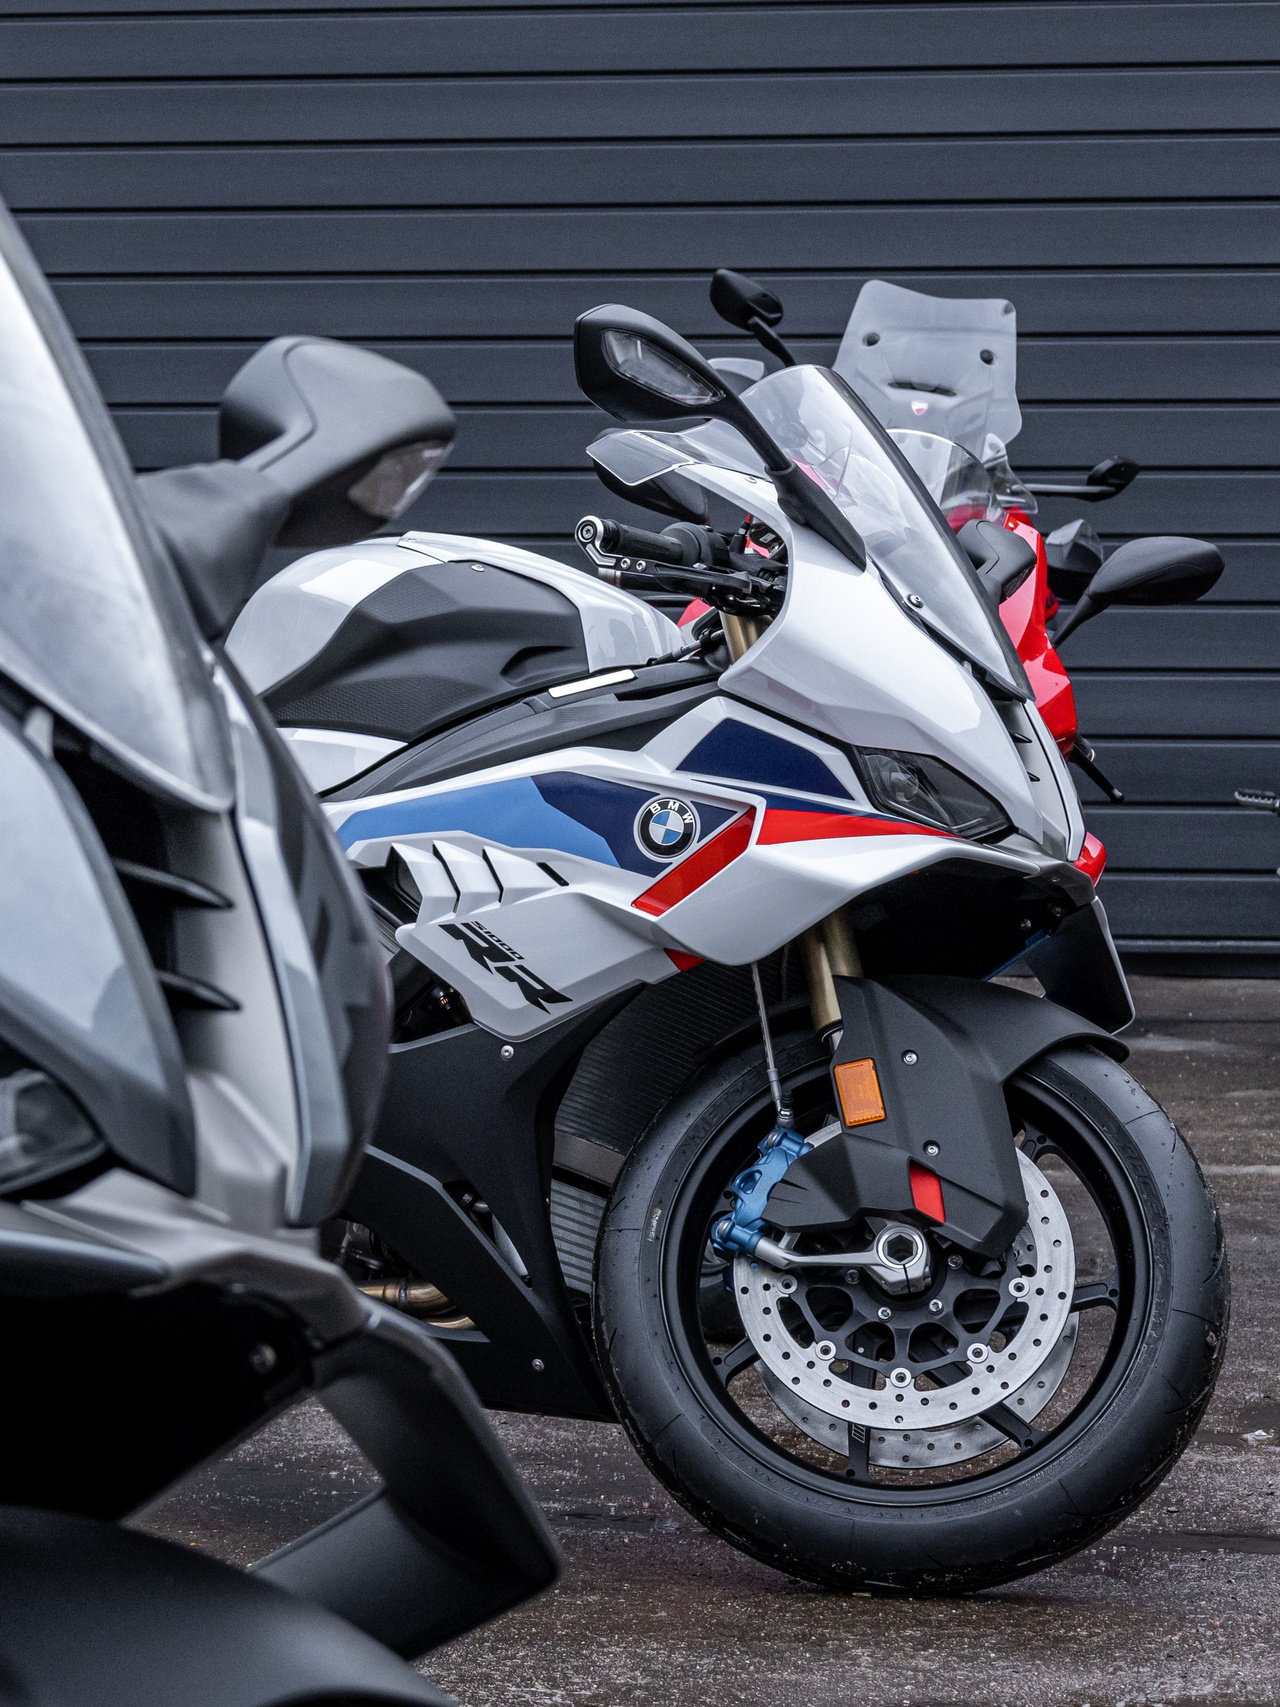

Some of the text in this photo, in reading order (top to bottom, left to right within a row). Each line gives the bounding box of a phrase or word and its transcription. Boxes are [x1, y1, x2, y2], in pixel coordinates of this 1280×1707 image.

[649, 800, 694, 824] BMW
[470, 920, 526, 961] S1000
[437, 922, 574, 1015] RR
